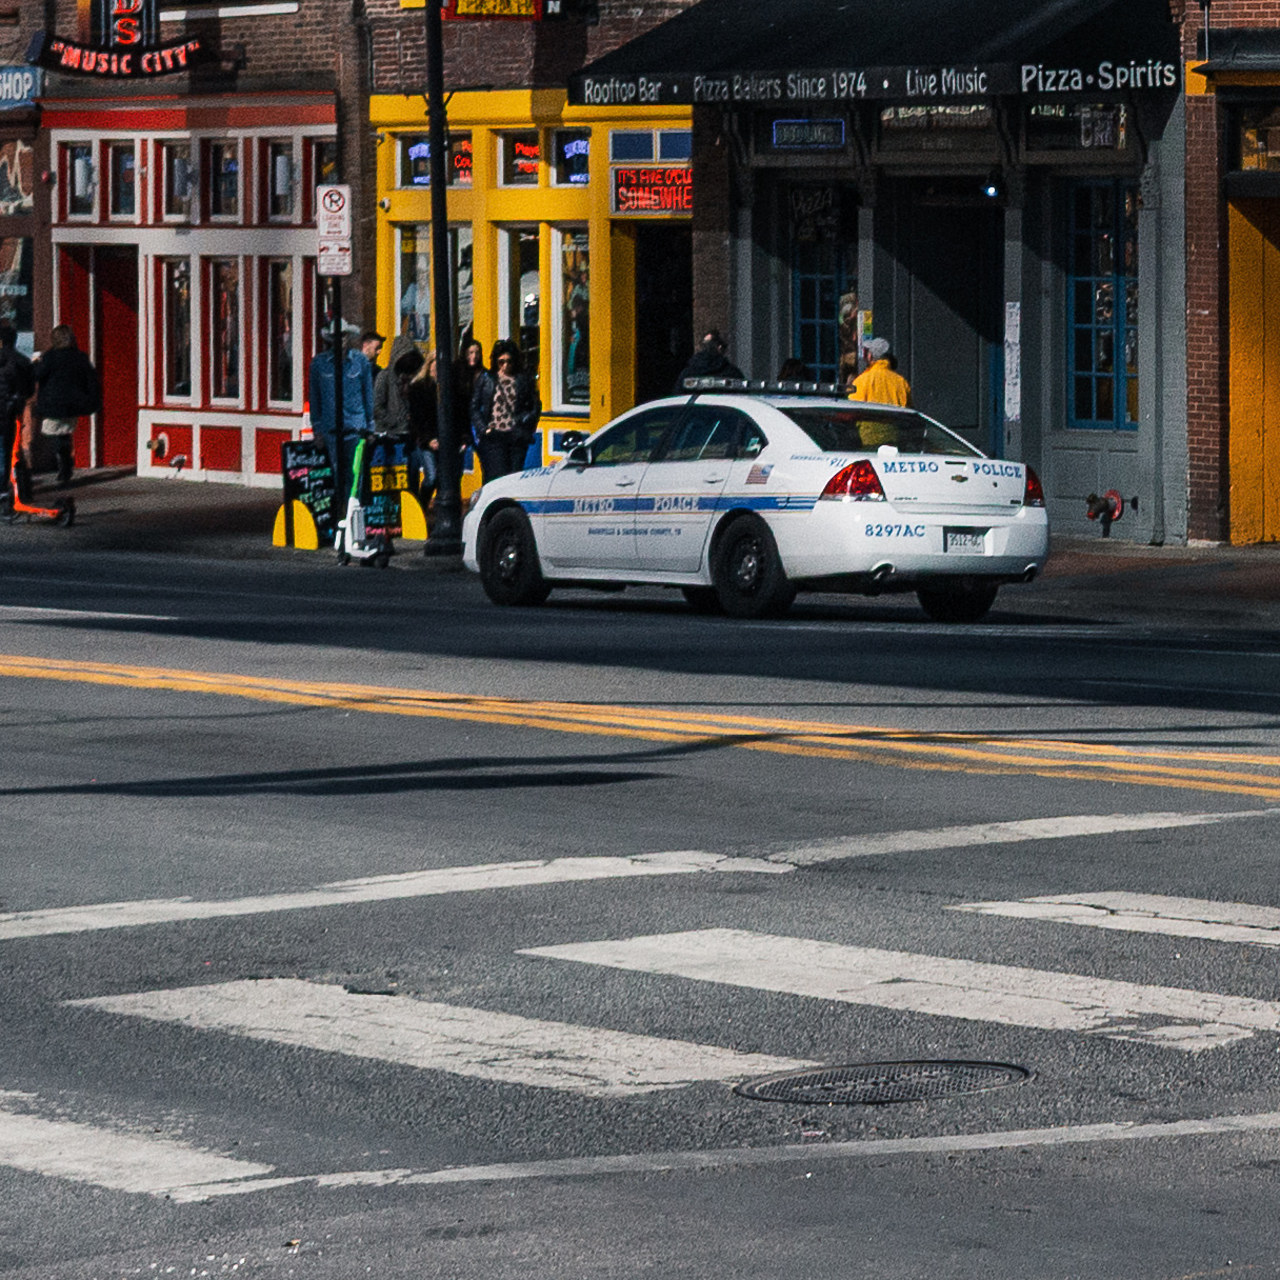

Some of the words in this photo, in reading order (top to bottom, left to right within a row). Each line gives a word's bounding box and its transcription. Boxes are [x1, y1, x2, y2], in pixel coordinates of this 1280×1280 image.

[585, 77, 636, 103] Rooftop
[638, 77, 662, 102] Bar
[694, 76, 729, 102] Pizza
[733, 75, 782, 100] Bakers
[787, 74, 826, 98] Since
[832, 71, 867, 98] 1974
[907, 69, 938, 96] Live
[942, 67, 988, 95] Music
[1021, 64, 1083, 92] Pizza
[1098, 60, 1176, 94] Spirits
[618, 185, 693, 210] SOMEWHE
[883, 461, 939, 474] METRO
[972, 462, 1023, 479] POLICE
[573, 499, 614, 513] METRO
[655, 497, 699, 511] POLICE
[864, 524, 926, 538] 8297AC
